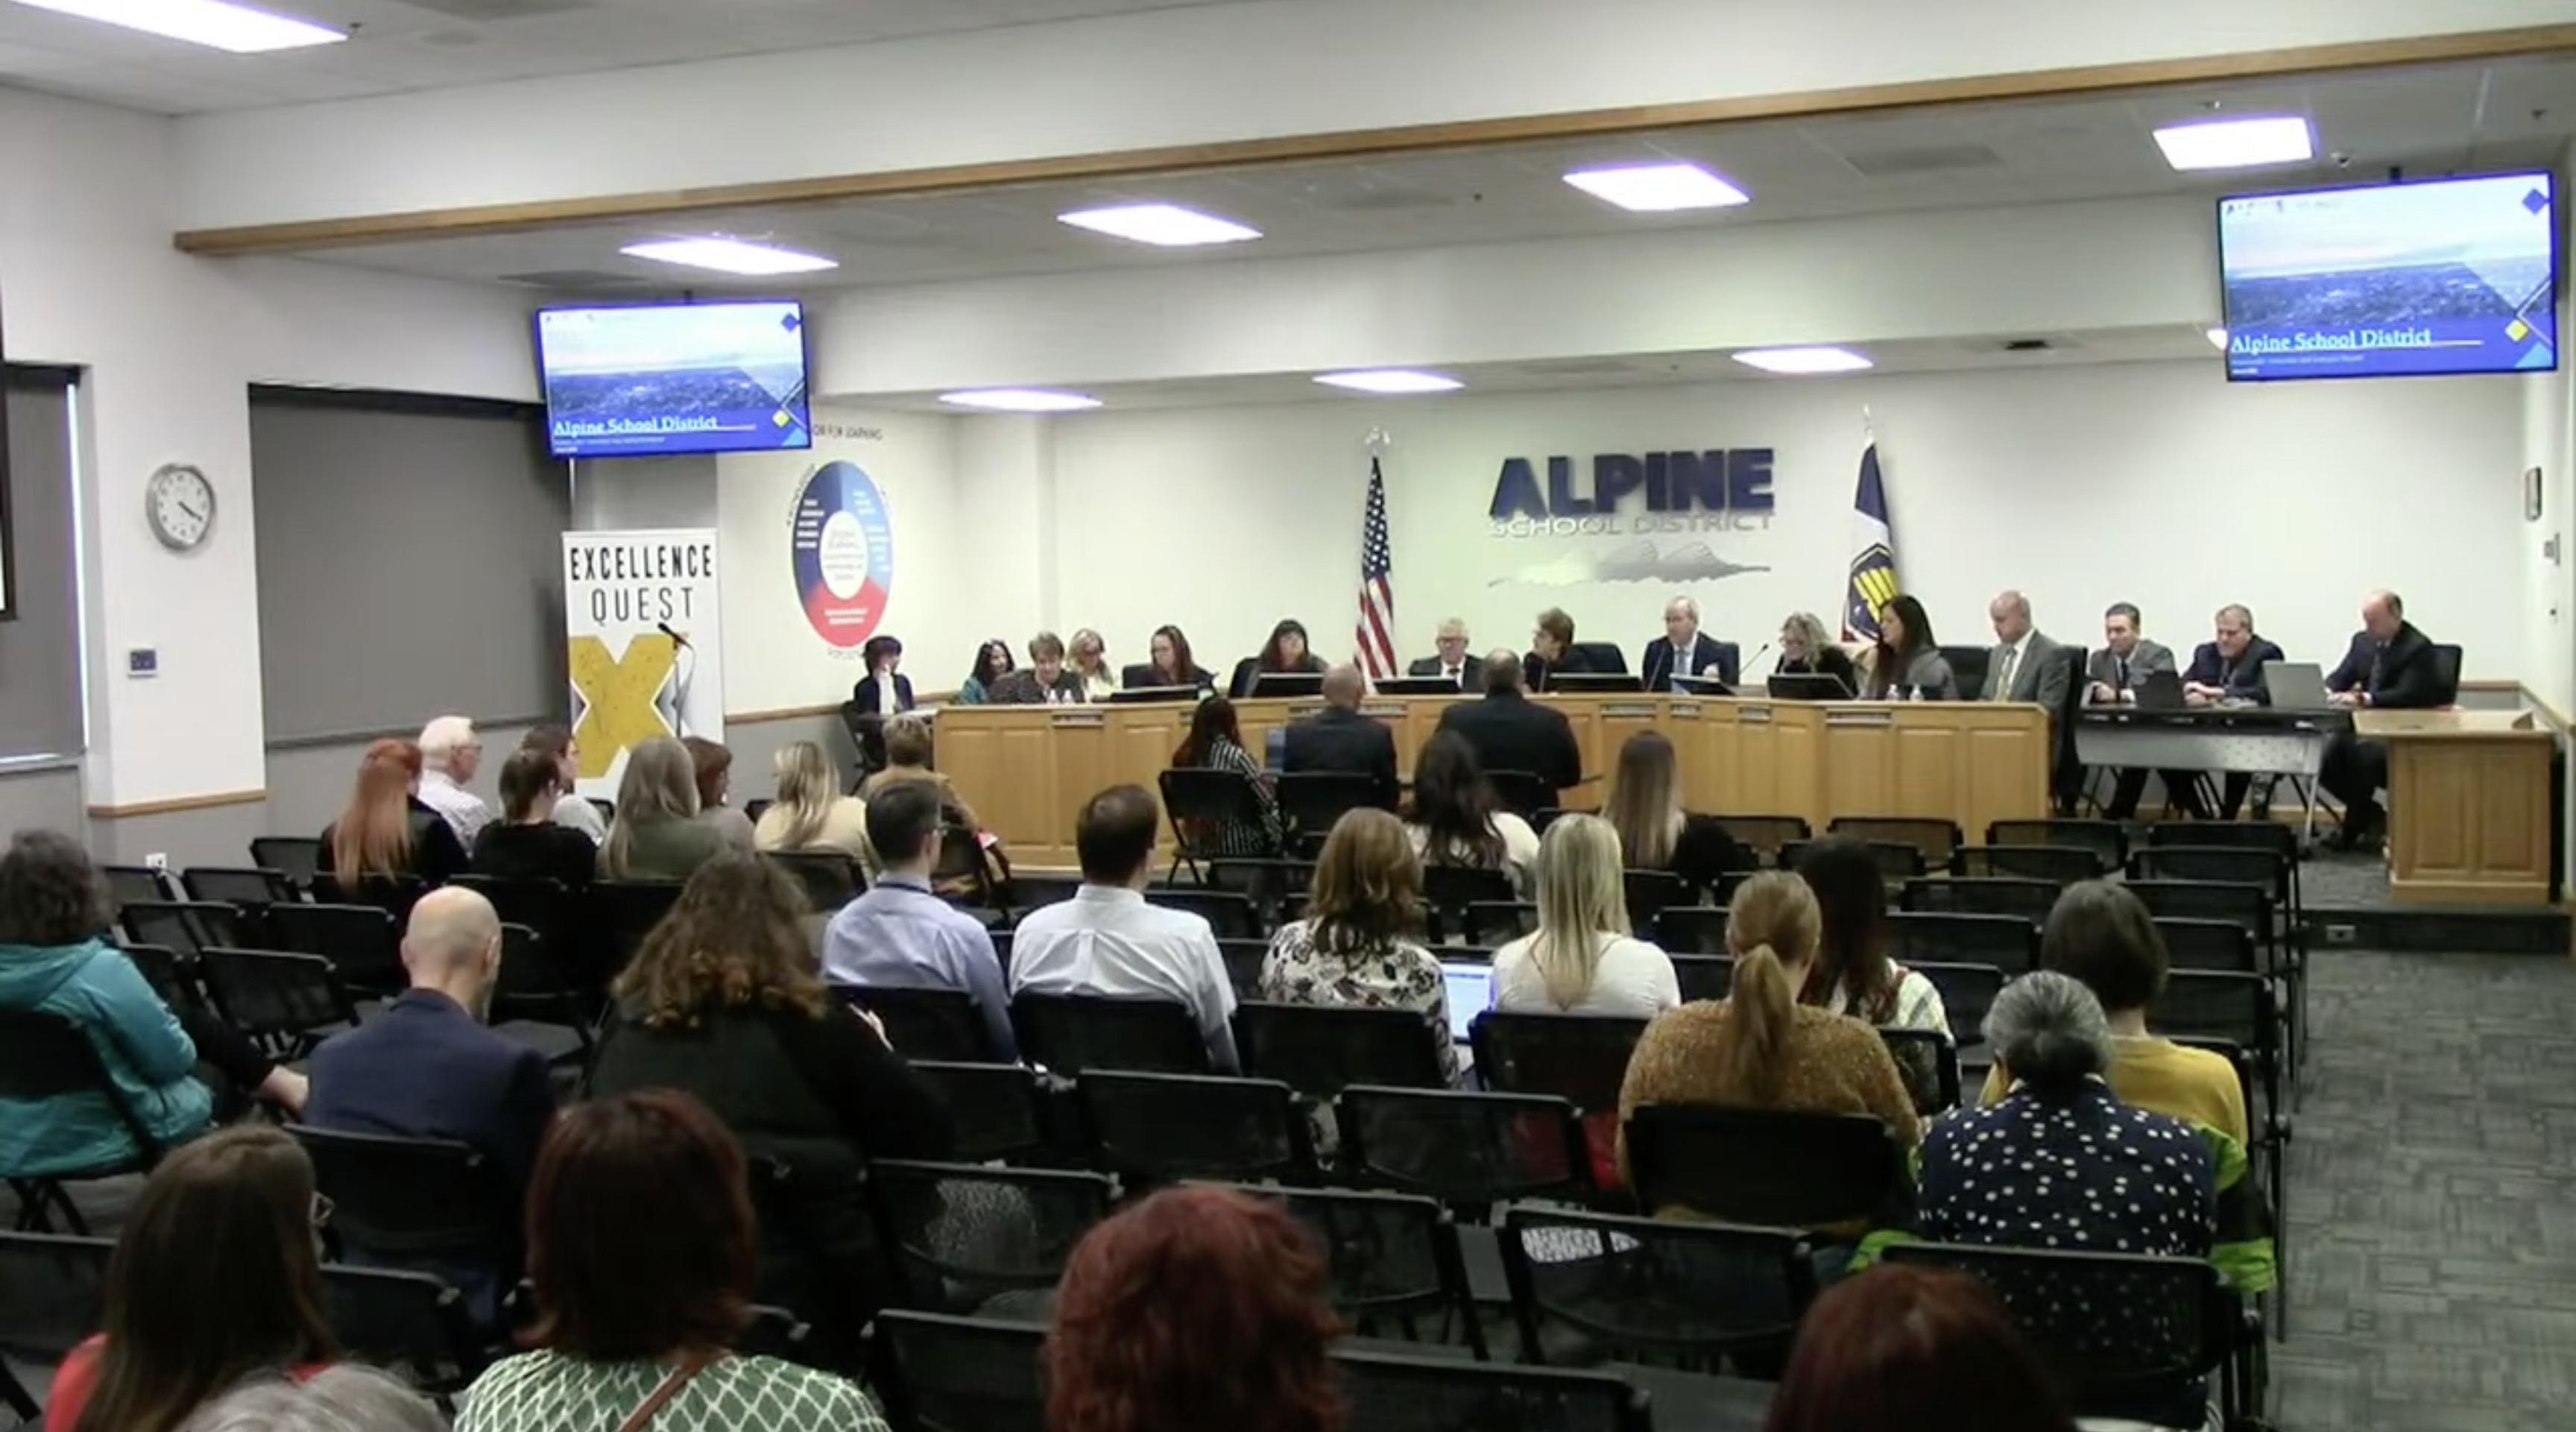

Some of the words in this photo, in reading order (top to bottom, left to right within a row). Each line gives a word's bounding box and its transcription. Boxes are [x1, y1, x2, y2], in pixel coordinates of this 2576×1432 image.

[2230, 335, 2290, 355] Alpine
[2294, 332, 2356, 350] School
[2361, 329, 2431, 347] District
[554, 420, 604, 437] Alpine
[607, 417, 657, 433] School
[662, 415, 718, 431] District
[1489, 448, 1775, 519] ALPINE
[1489, 514, 1624, 537] SCHOOL
[1634, 511, 1775, 534] DISTRICT
[571, 545, 712, 581] EXCELLENCE
[591, 587, 693, 625] QUEST
